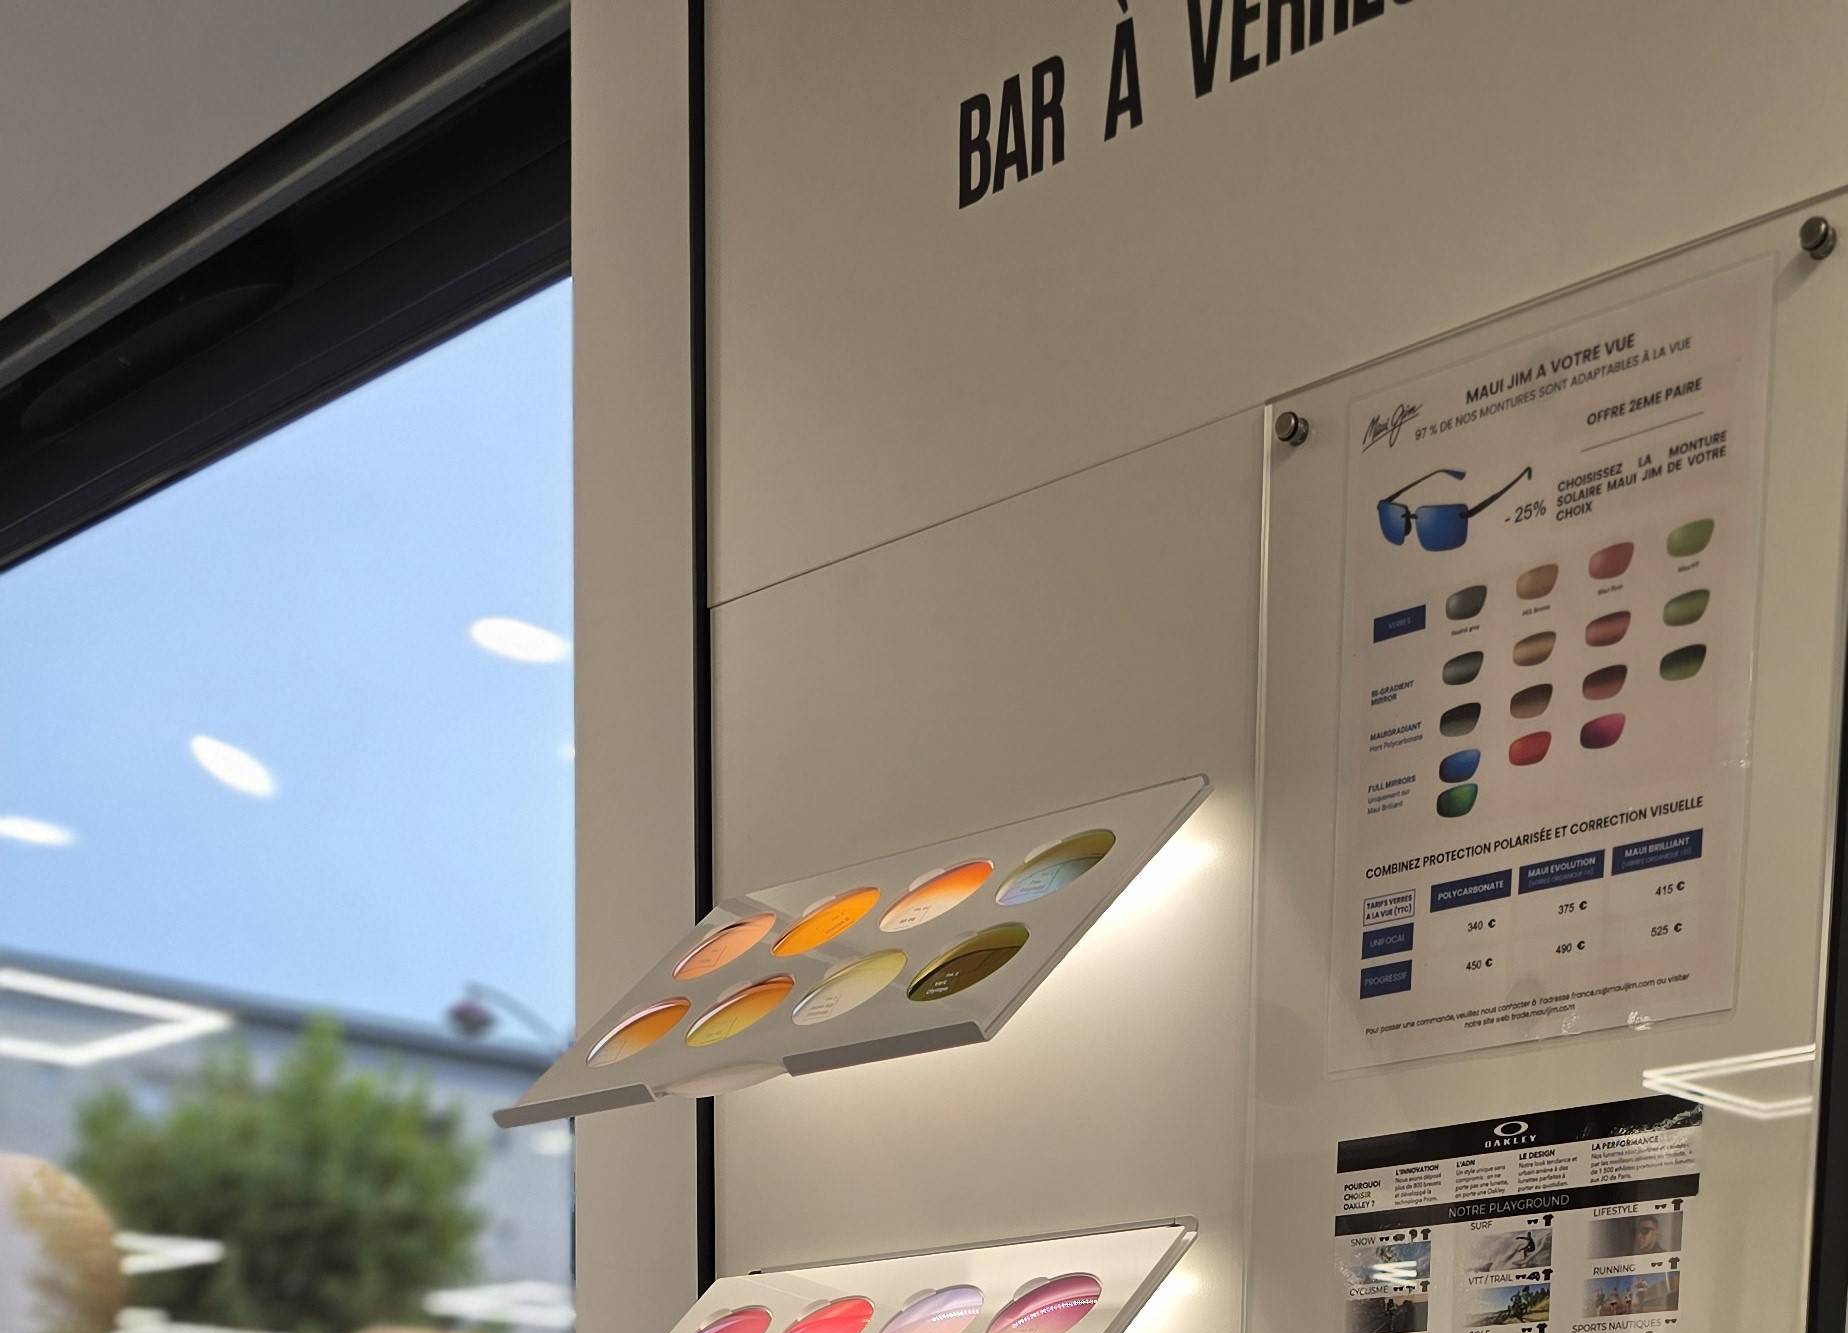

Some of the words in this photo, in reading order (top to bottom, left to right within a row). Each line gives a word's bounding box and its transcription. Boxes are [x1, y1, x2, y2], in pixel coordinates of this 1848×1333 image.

[958, 55, 1065, 210] BAR
[1104, 0, 1143, 142] À
[1466, 379, 1504, 405] MAUI
[1507, 368, 1533, 390] JIM
[1536, 364, 1547, 379] A
[1550, 345, 1601, 373] VOTRE
[1604, 332, 1635, 355] VUE
[1415, 427, 1427, 440] 97
[1429, 423, 1438, 435] %
[1440, 419, 1453, 433] DE
[1455, 410, 1478, 427] NOS
[1479, 390, 1536, 418] MONTURES
[1538, 379, 1567, 397] SONT
[1570, 355, 1639, 387] ADAPTABLES
[1641, 347, 1650, 363] À
[1652, 347, 1665, 360] LA
[1669, 337, 1692, 354] VUE
[1587, 402, 1626, 425] OFFRE
[1628, 391, 1662, 414] 2EME
[1664, 377, 1703, 401] PAIRE
[1557, 463, 1623, 492] CHOISISSEZ
[1638, 454, 1652, 468] LA
[1668, 430, 1727, 458] MONTURE
[1556, 484, 1602, 507] SOLAIRE
[1606, 473, 1637, 492] MAUI
[1642, 465, 1663, 481] JIM
[1667, 459, 1682, 474] DE
[1687, 445, 1727, 467] VOTRE
[1556, 501, 1593, 522] CHOIX
[1365, 858, 1421, 879] COMBINEZ
[1423, 842, 1491, 867] PROTECTION
[1494, 827, 1552, 852] POLARISÉE
[1554, 825, 1568, 839] ET
[1570, 808, 1647, 835] CORRECTION
[1650, 796, 1703, 818] VISUELLE
[1624, 846, 1647, 857] MAUI
[1649, 836, 1690, 852] BRILLIANT
[1528, 866, 1549, 878] MAUI
[1551, 856, 1596, 873] EVOLUTION
[1437, 880, 1504, 901] POLYCARBONATE
[1655, 884, 1673, 896] 415
[1676, 881, 1686, 891] €
[1558, 902, 1575, 915] 375
[1579, 900, 1588, 911] €
[1467, 921, 1483, 932] 340
[1487, 918, 1496, 929] €
[1651, 925, 1669, 937] 525
[1674, 922, 1683, 932] €
[1555, 943, 1572, 954] 490
[1577, 940, 1586, 950] €
[1465, 960, 1482, 971] 450
[1485, 958, 1493, 967] €
[1484, 1134, 1537, 1148] OAKLEY
[1519, 1153, 1527, 1161] LE
[1528, 1149, 1555, 1160] DESIGN
[1456, 1160, 1475, 1168] L'ADN
[1344, 1180, 1381, 1191] POURQUOI
[1343, 1191, 1371, 1201] CHOISIR
[1448, 1204, 1486, 1218] NOTRE
[1489, 1195, 1570, 1215] PLAYGROUND
[1593, 1204, 1639, 1217] LIFESTYLE
[1470, 1221, 1493, 1231] SURF
[1350, 1237, 1376, 1247] SNOW
[1593, 1263, 1636, 1276] RUNNING
[1349, 1285, 1388, 1297] CYCLISME
[1571, 1322, 1606, 1333] SPORTS
[1608, 1318, 1662, 1330] NAUTIQUES
